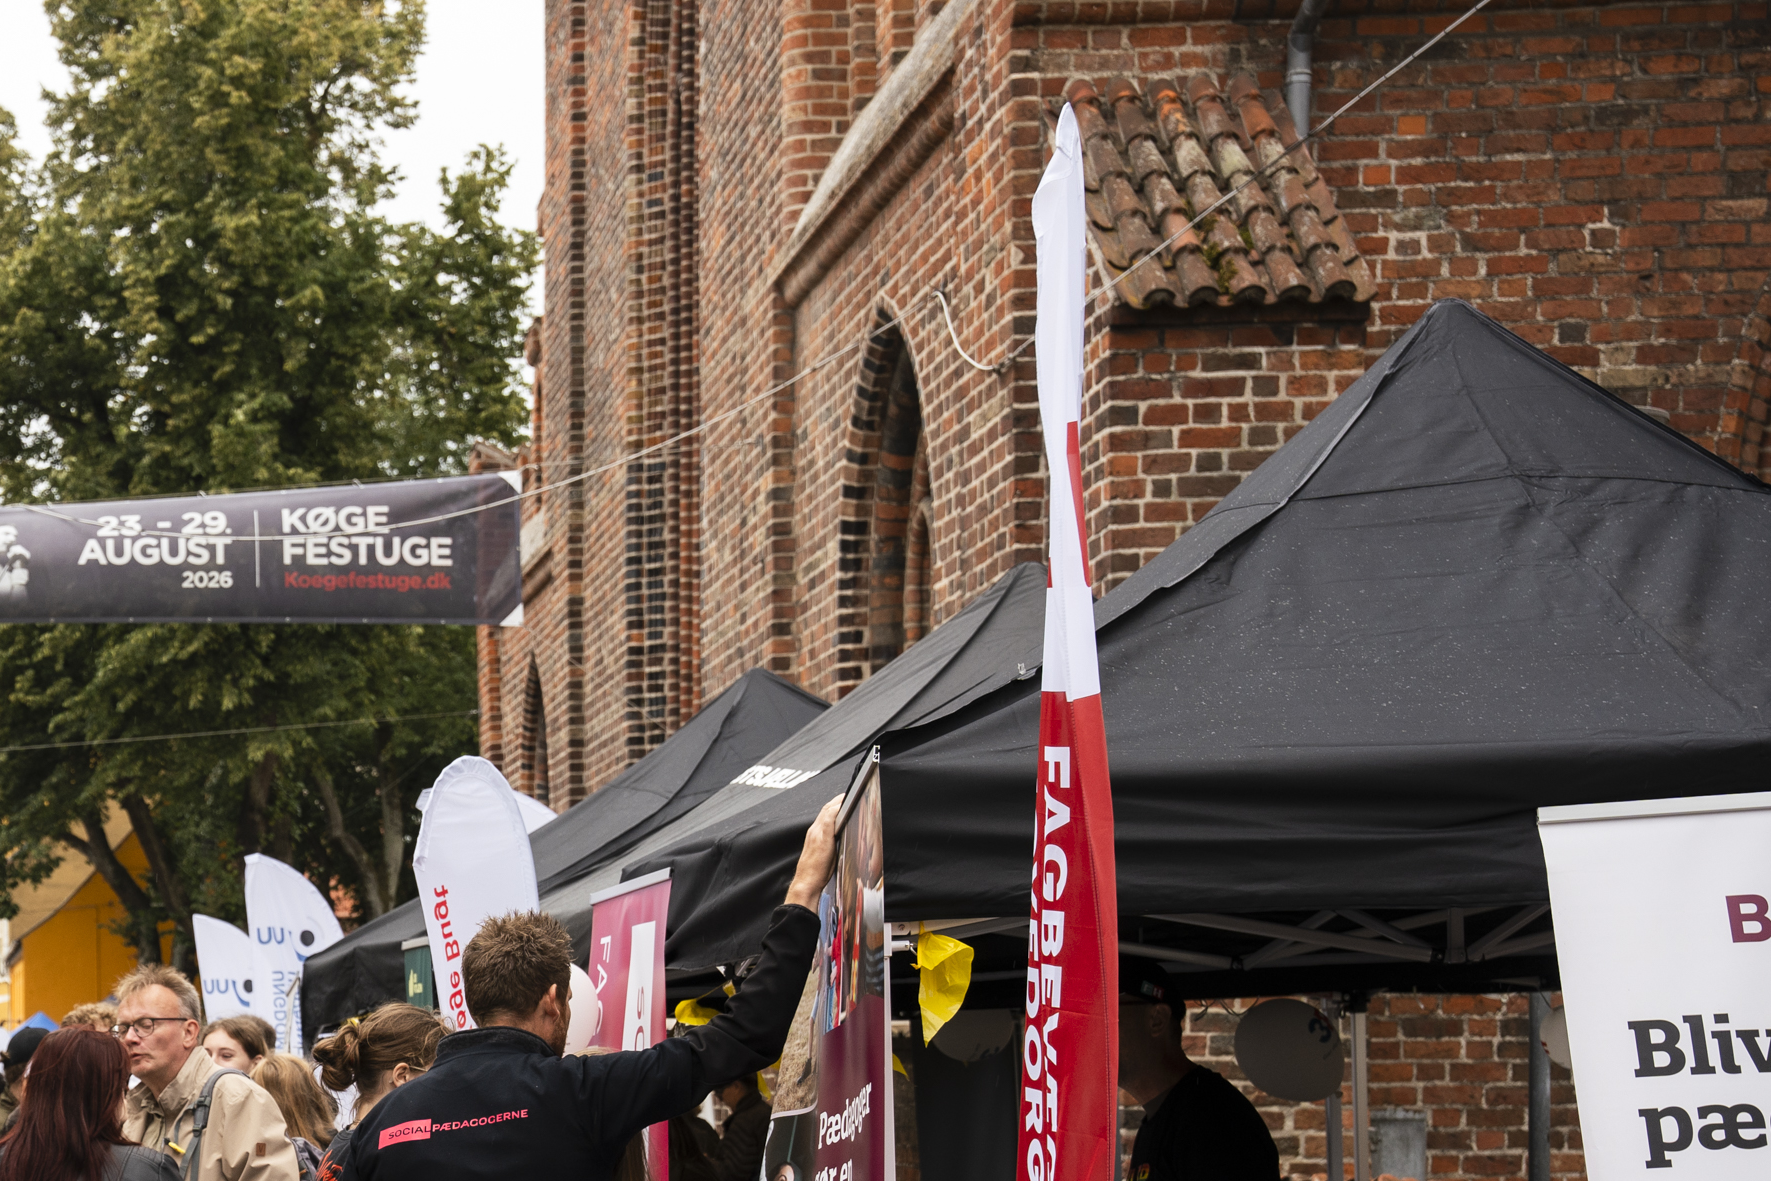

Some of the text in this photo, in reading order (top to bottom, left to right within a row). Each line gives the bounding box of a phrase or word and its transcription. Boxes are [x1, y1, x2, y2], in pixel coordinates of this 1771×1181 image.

[181, 511, 232, 535] 29.
[282, 505, 390, 534] KØGE
[78, 537, 232, 566] AUGUST
[283, 536, 453, 567] FESTUGE
[182, 571, 233, 589] 2026
[285, 572, 451, 592] Koegefestuge.dk
[1628, 1013, 1771, 1077] Bliv
[818, 1082, 872, 1149] Pædagoger
